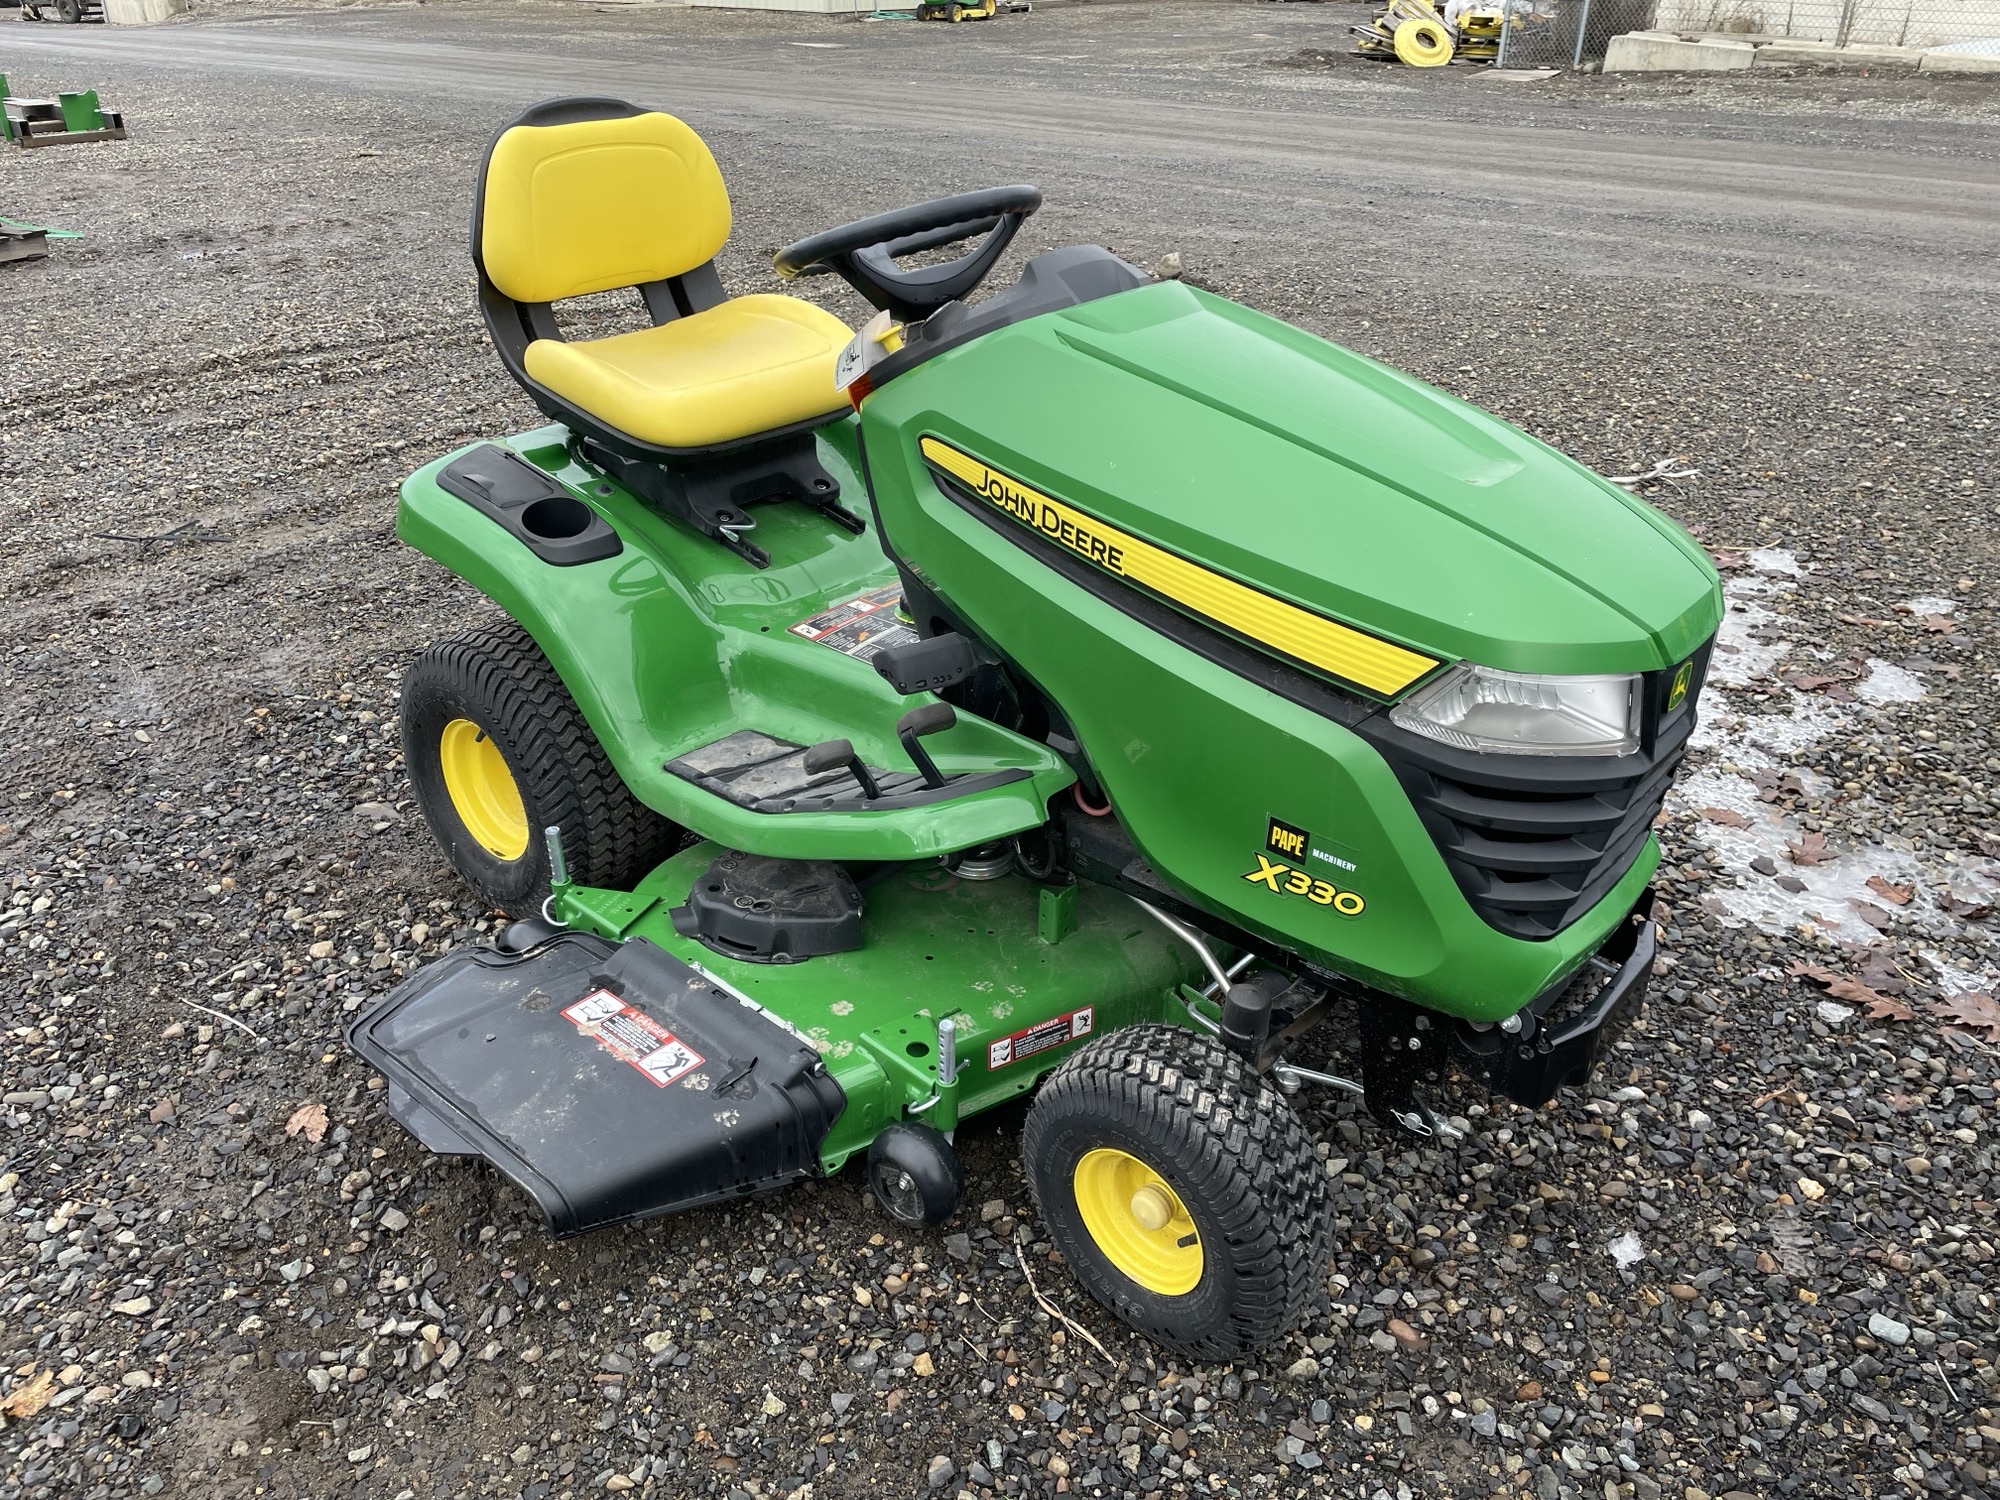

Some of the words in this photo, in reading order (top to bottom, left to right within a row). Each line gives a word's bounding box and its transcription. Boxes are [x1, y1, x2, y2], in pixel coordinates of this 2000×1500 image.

[976, 469, 1036, 523] JOHN
[1041, 504, 1124, 571] DEERE
[1311, 848, 1357, 872] MACHINERY
[1241, 851, 1366, 916] X330
[635, 1013, 670, 1040] DANGER
[1033, 1018, 1059, 1033] DANGER
